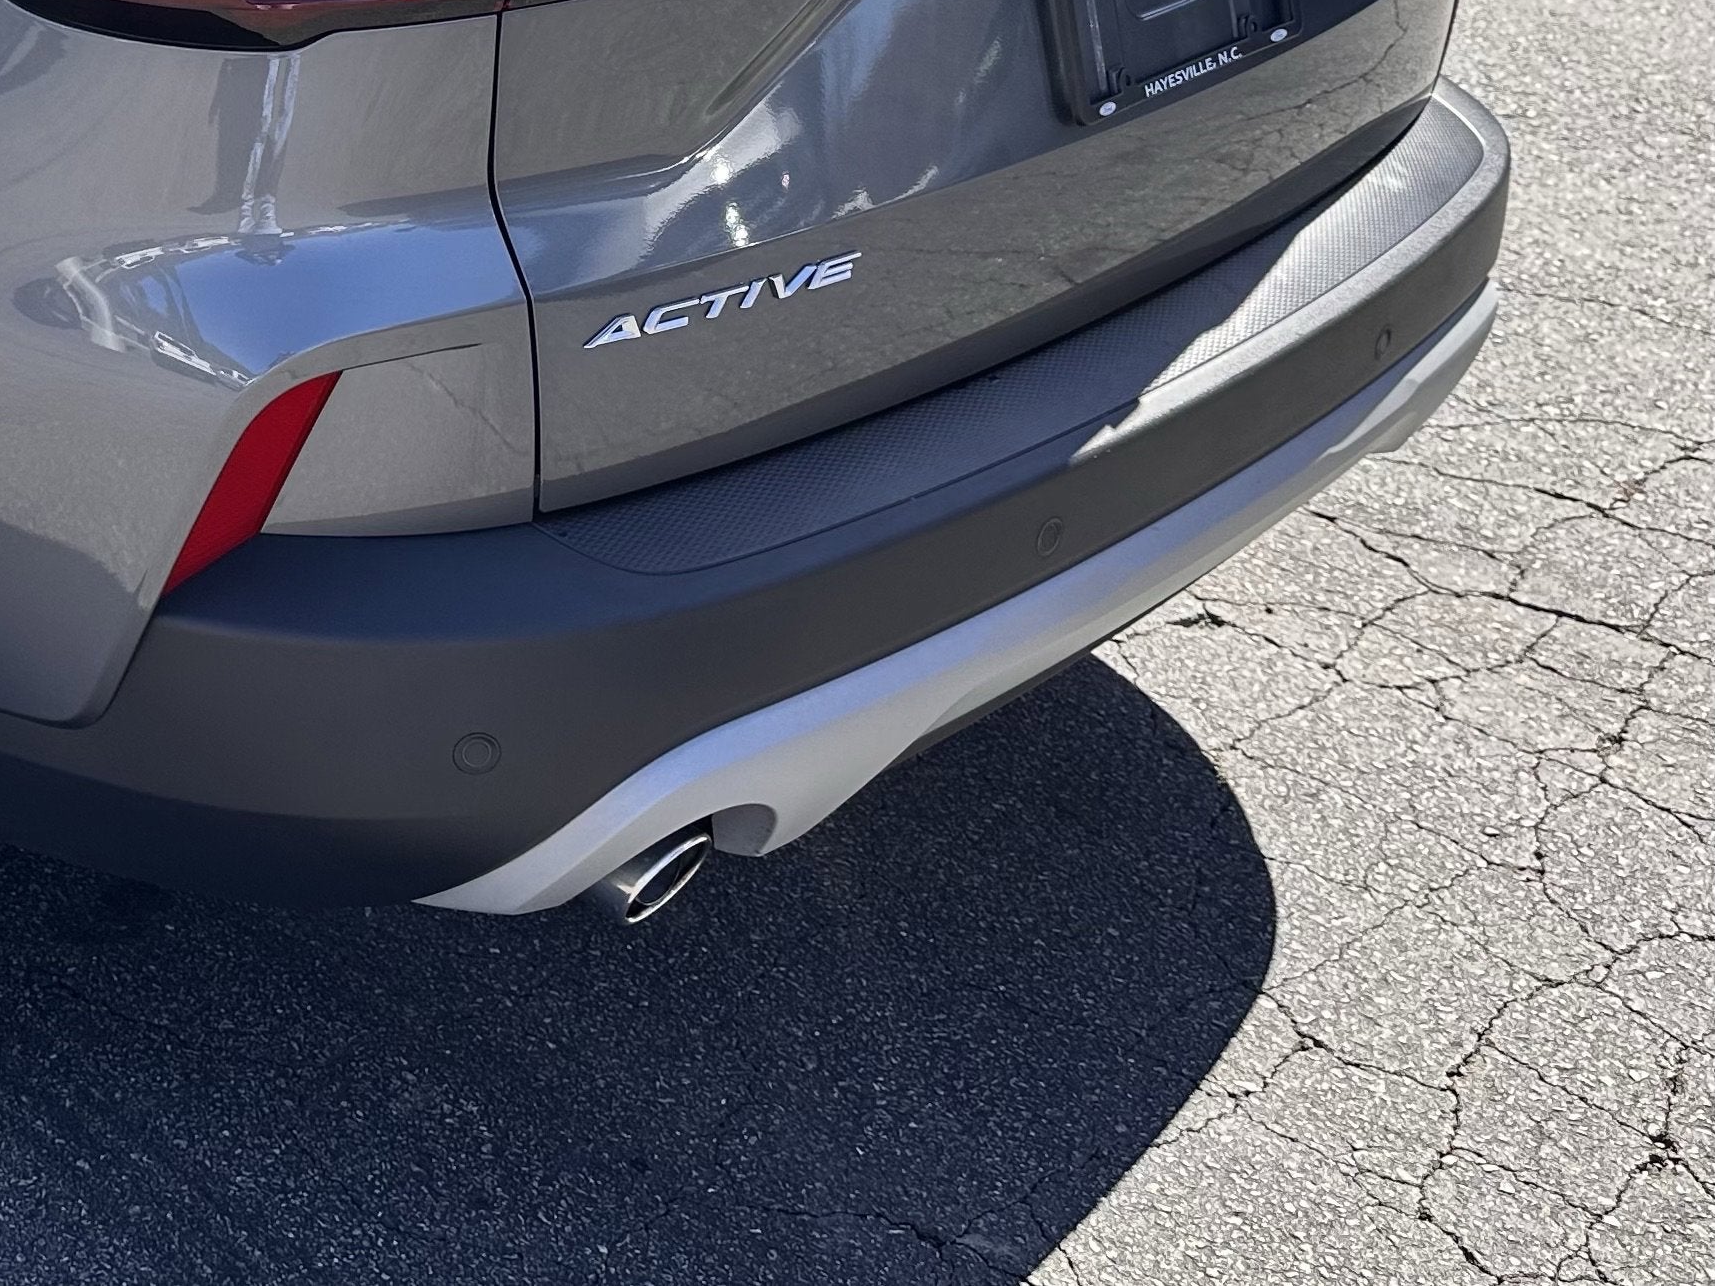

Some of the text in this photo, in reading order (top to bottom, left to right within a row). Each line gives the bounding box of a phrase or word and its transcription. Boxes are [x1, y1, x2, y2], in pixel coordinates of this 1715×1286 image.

[1144, 46, 1243, 98] HAYESVILLE, N.C.
[583, 250, 863, 350] ACTIVE
